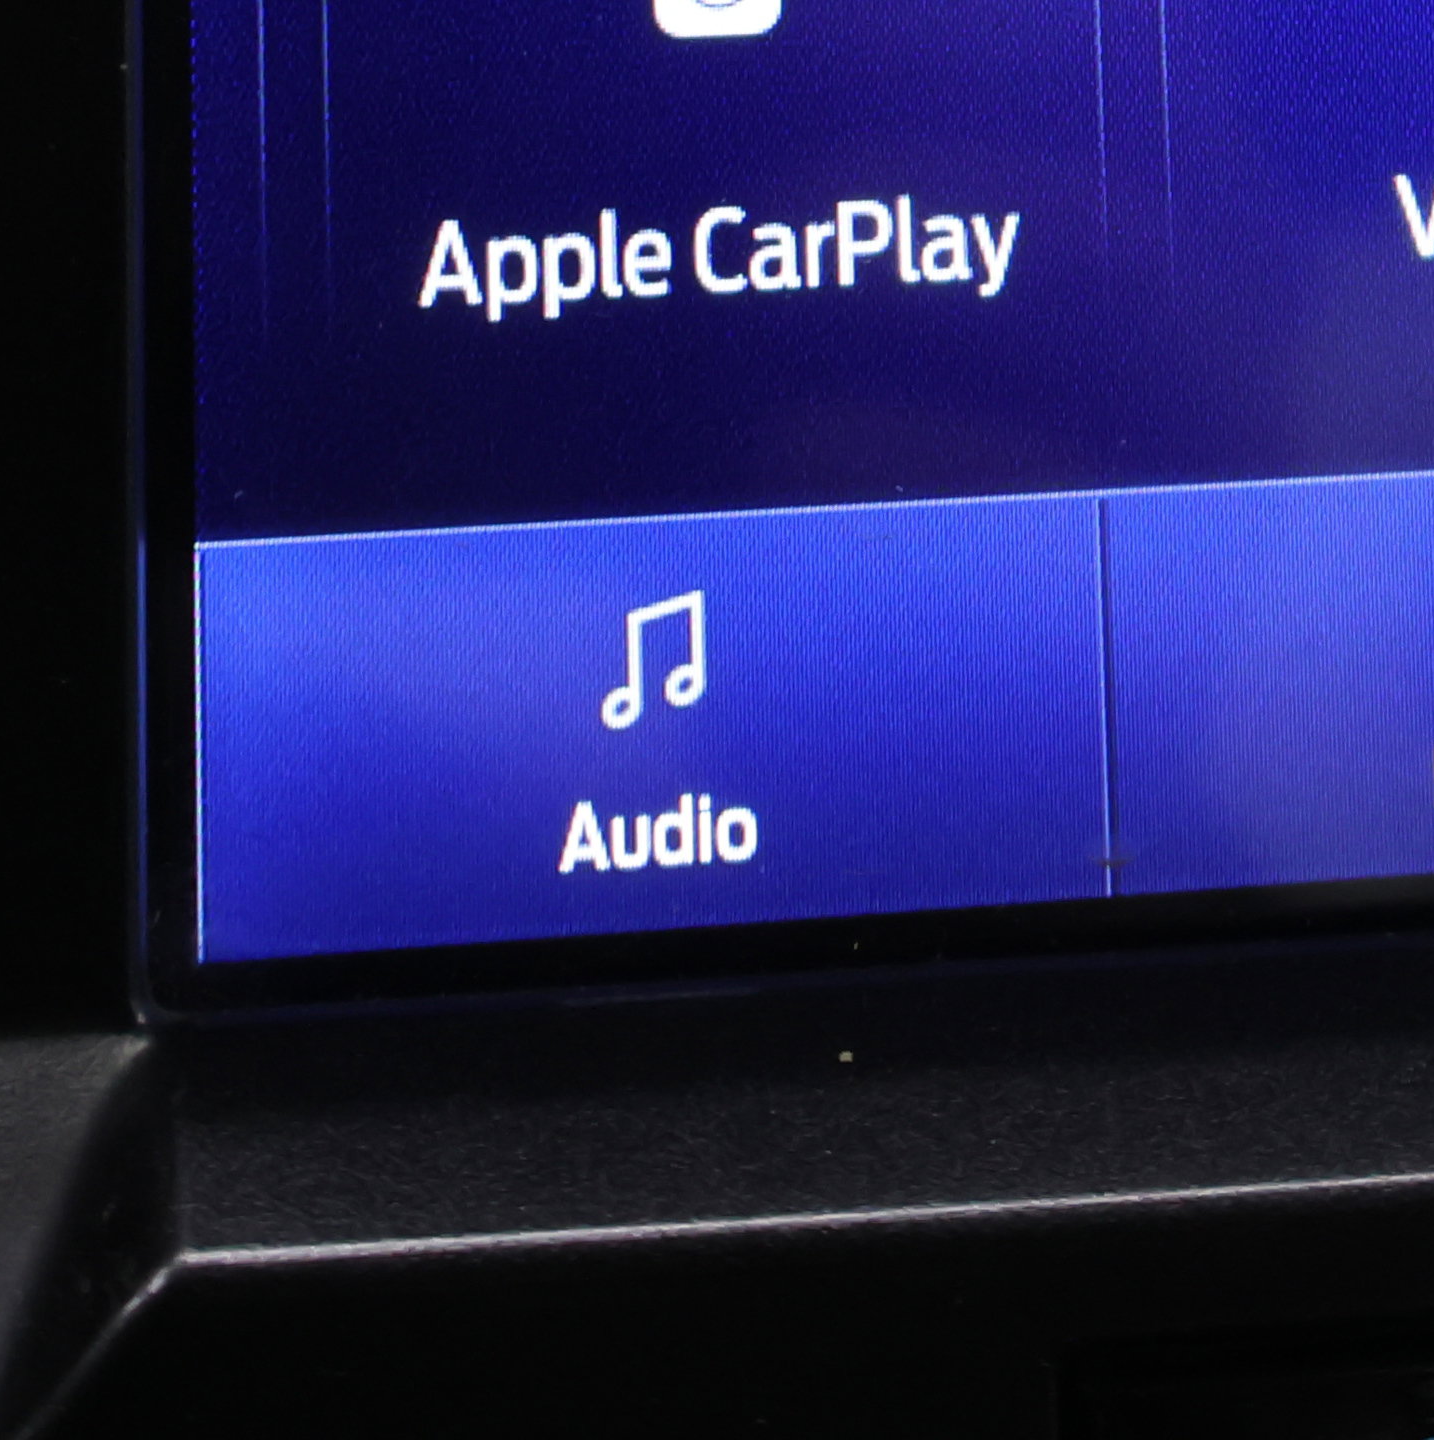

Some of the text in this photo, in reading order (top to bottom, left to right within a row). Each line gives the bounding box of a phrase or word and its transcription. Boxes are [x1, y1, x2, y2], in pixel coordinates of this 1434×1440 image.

[417, 194, 1021, 323] Apple CarPlay
[557, 792, 759, 874] Audio
